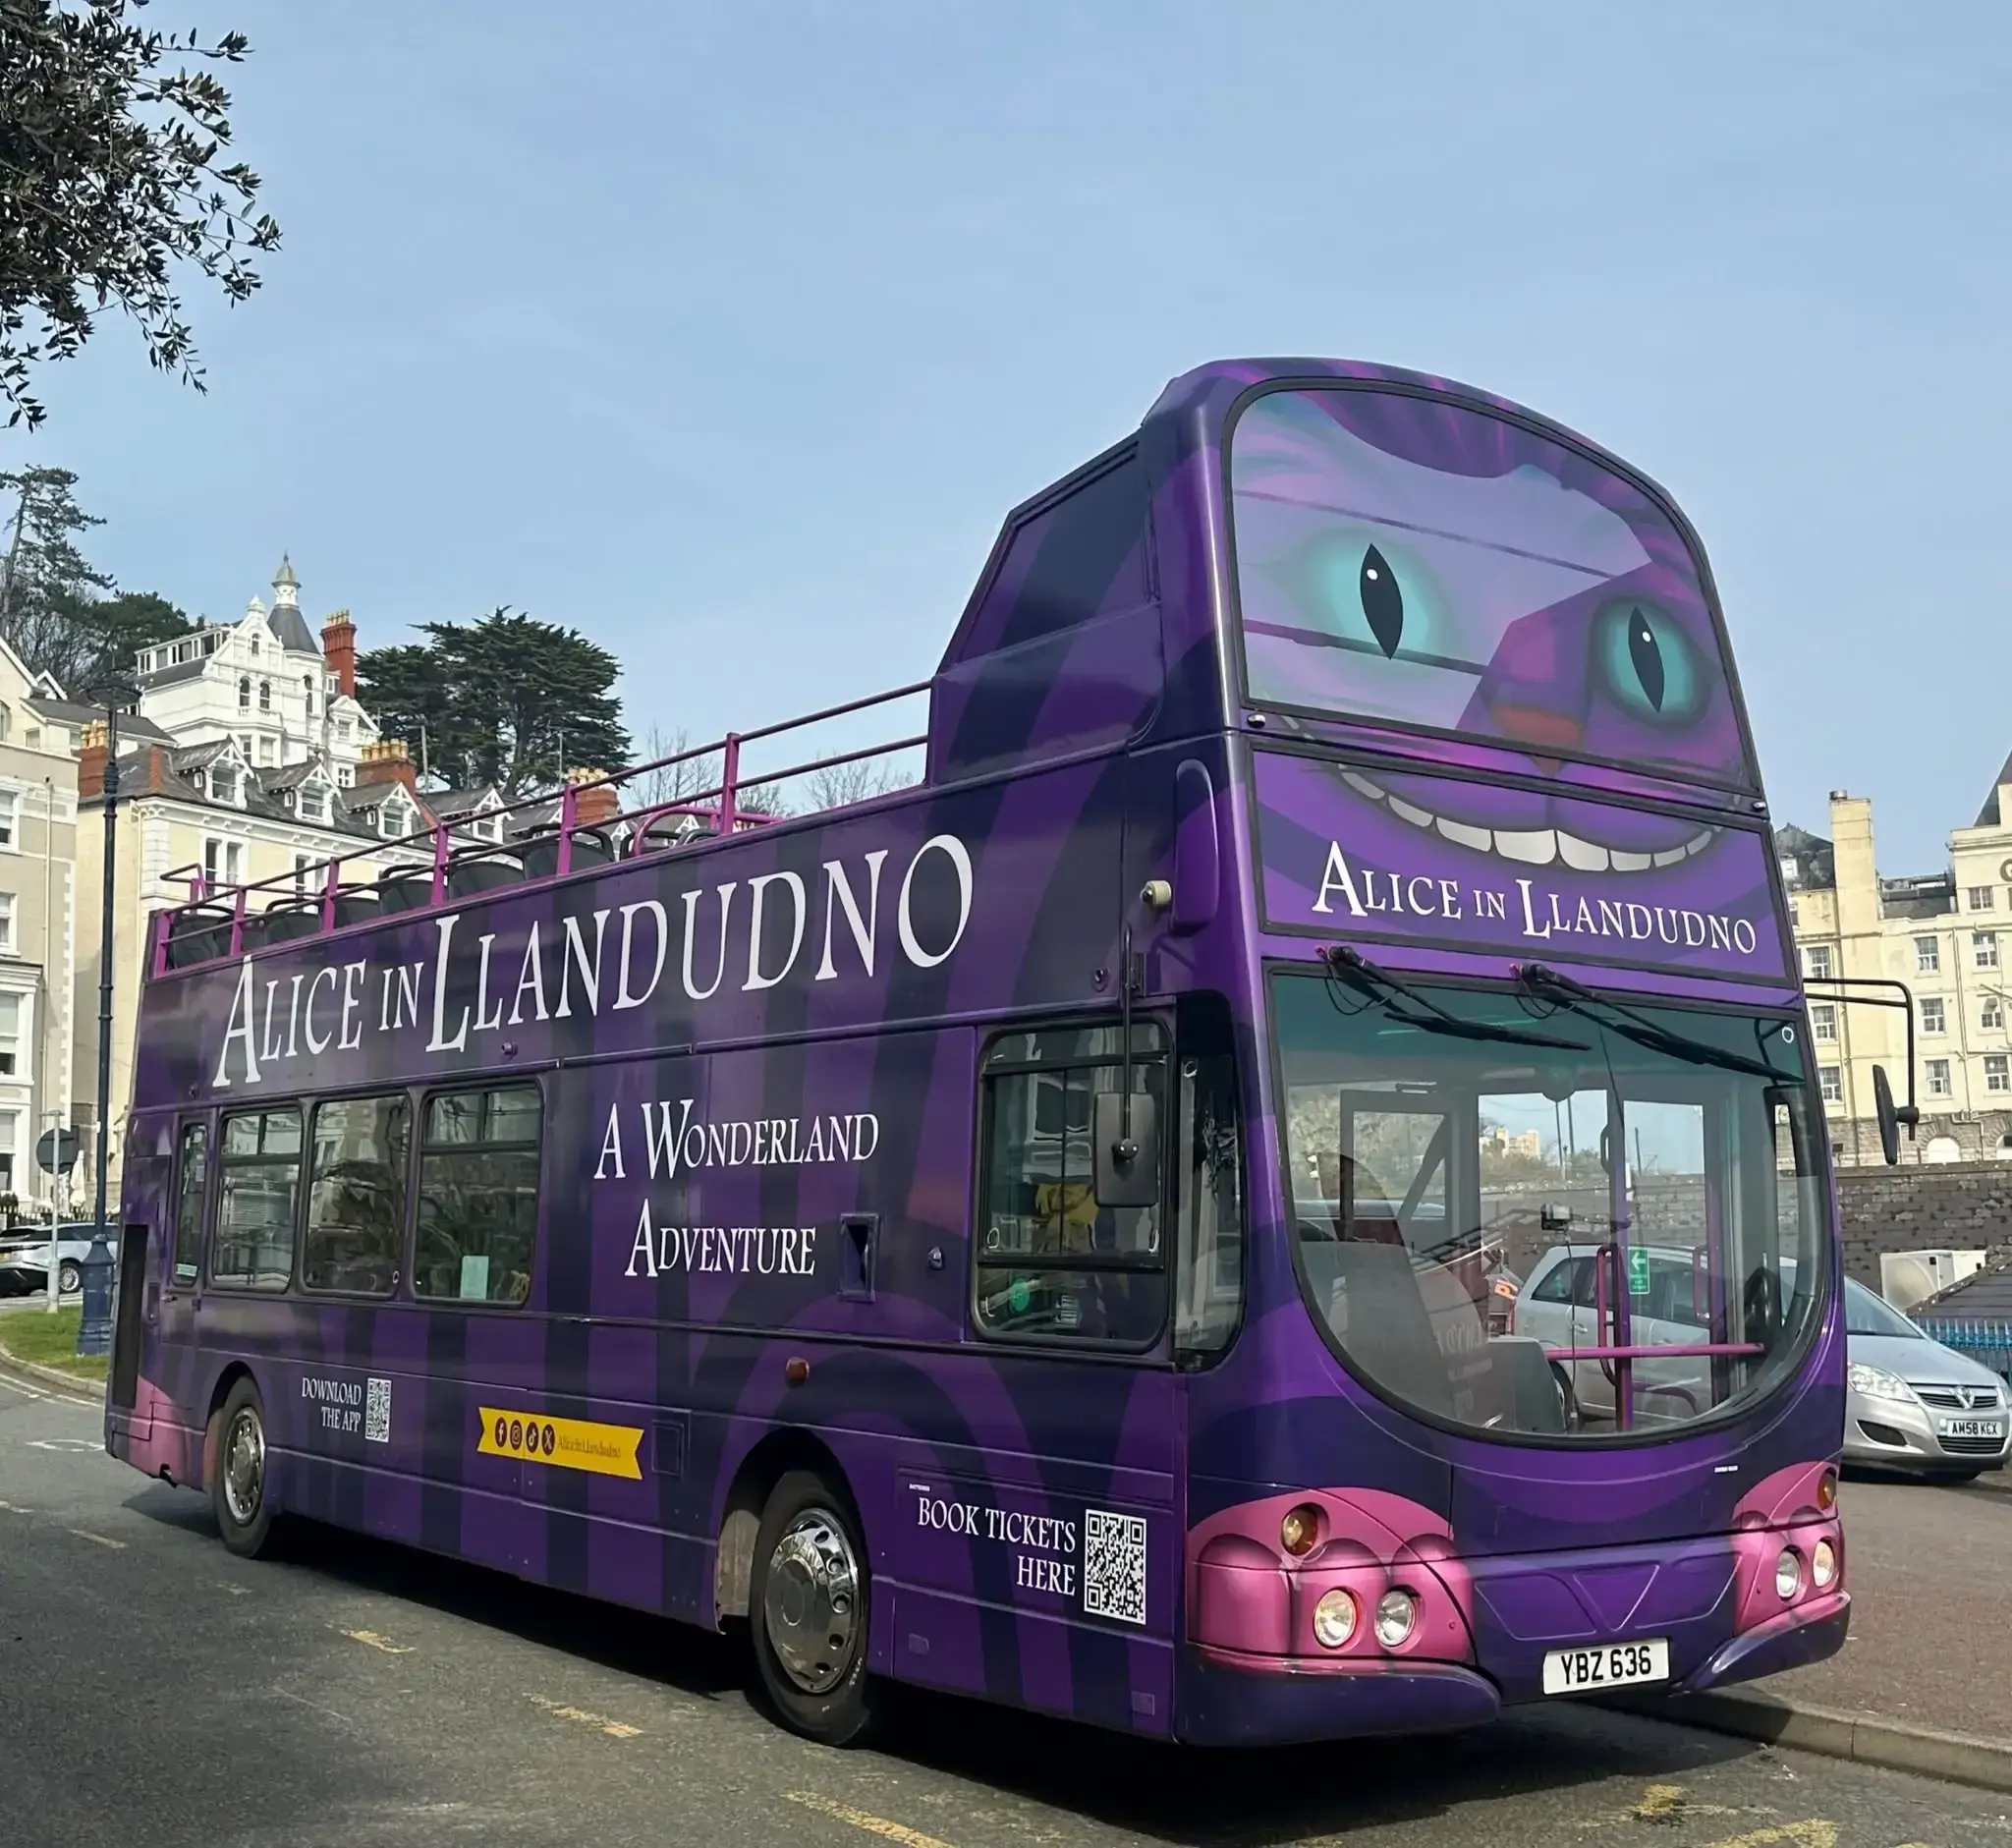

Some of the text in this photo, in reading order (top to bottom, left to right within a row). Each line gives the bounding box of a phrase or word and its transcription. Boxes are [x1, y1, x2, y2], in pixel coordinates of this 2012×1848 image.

[1312, 840, 1757, 954] ALICE IN LLANDUDNO
[212, 833, 974, 1088] ALICE IN LLANDUDNO
[593, 1098, 879, 1179] A WONDERLAND
[624, 1198, 816, 1277] ADVENTURE
[302, 1376, 362, 1406] DOWNLOAD
[320, 1406, 362, 1432] THE APP
[1952, 1422, 1979, 1435] AM58
[918, 1496, 1076, 1552] BOOK TICKETS
[1016, 1555, 1076, 1596] HERE
[1560, 1645, 1651, 1685] YBZ 636
